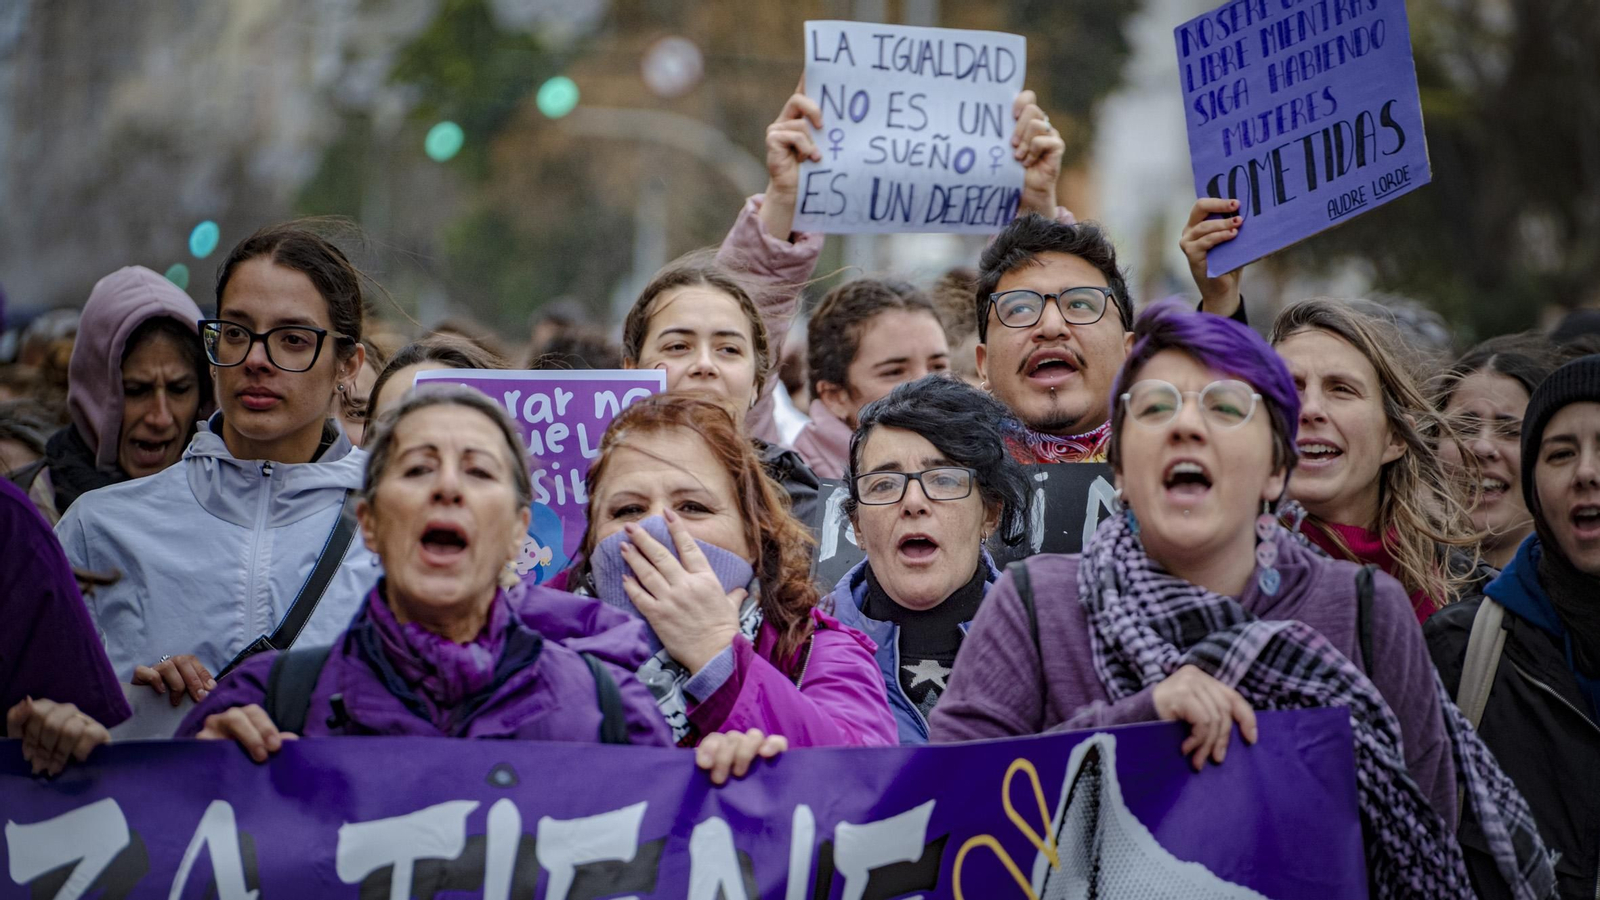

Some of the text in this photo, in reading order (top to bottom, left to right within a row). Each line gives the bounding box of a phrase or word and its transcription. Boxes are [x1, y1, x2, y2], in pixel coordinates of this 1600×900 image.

[812, 30, 1016, 84] LA IGUALDAD
[1185, 36, 1252, 93] LIBRE
[1193, 19, 1386, 127] SIGA HABIENDO
[820, 83, 1004, 139] NO ES UN
[1222, 85, 1338, 157] MUJERES
[863, 133, 976, 174] SUEÑO
[800, 169, 1021, 226] ES UN DERECHO
[1327, 165, 1411, 218] AUDRE LORDE
